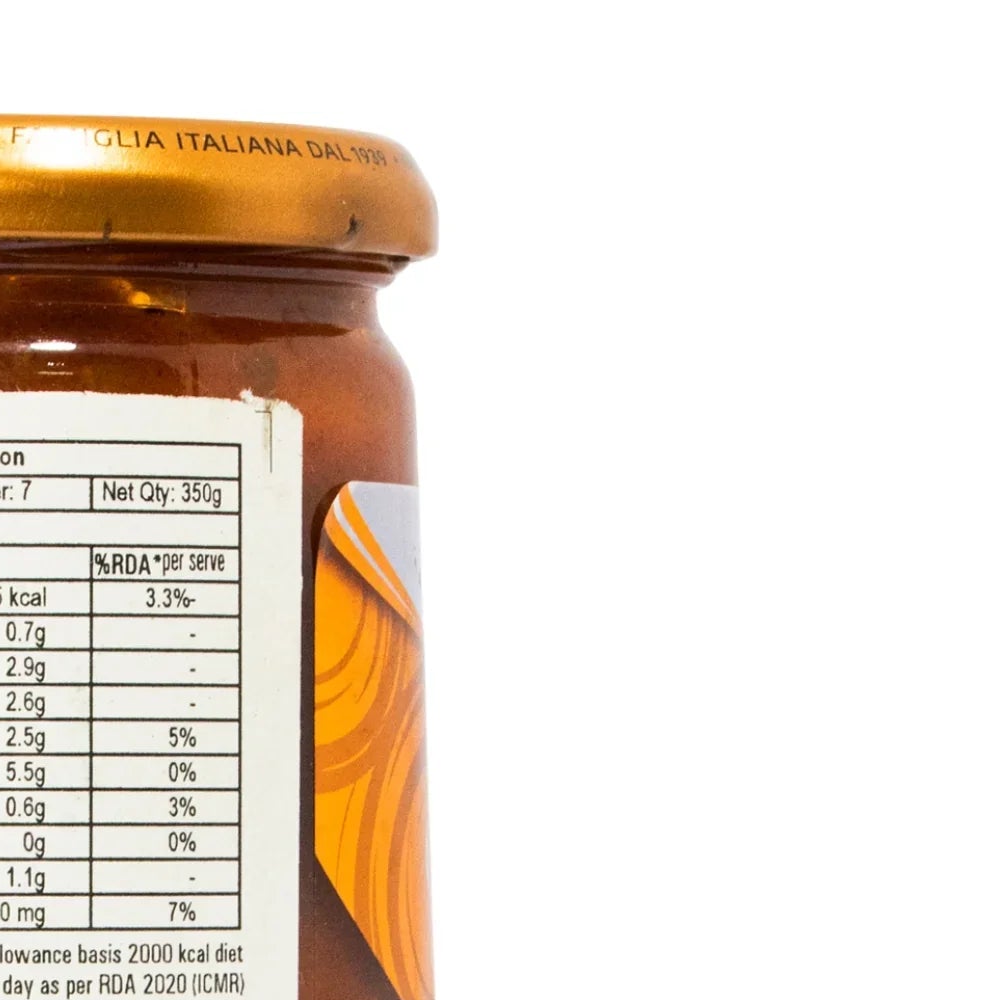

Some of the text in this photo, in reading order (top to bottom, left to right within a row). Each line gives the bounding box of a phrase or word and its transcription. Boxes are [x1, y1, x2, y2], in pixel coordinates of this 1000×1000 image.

[177, 132, 303, 157] ITALIANA
[307, 140, 351, 162] DAL
[21, 480, 32, 500] 7
[103, 483, 222, 509] Net Qty: 350g
[189, 553, 225, 572] serve
[9, 586, 46, 607] kcal
[6, 621, 46, 648] 0.7g
[6, 656, 46, 682] 2.9g
[6, 691, 46, 717] 2.6g
[6, 726, 46, 752] 2.5g
[169, 726, 196, 748] 5%
[6, 761, 46, 787] 5.5g
[169, 762, 196, 782] 0%
[6, 796, 46, 822] 0.6g
[169, 797, 196, 817] 3%
[23, 832, 46, 859] 0g
[168, 831, 196, 852] 0%
[7, 866, 46, 893] 1.1g
[18, 906, 46, 929] mg
[169, 901, 196, 922] 7%
[78, 944, 121, 964] basis
[128, 943, 173, 964] 2000
[179, 943, 209, 963] kcal
[215, 943, 243, 963] diet
[3, 974, 34, 1000] day
[40, 980, 59, 995] as
[66, 980, 93, 1000] per
[99, 973, 136, 995] RDA
[143, 973, 187, 995] 2020
[192, 972, 245, 996] (ICMR)
